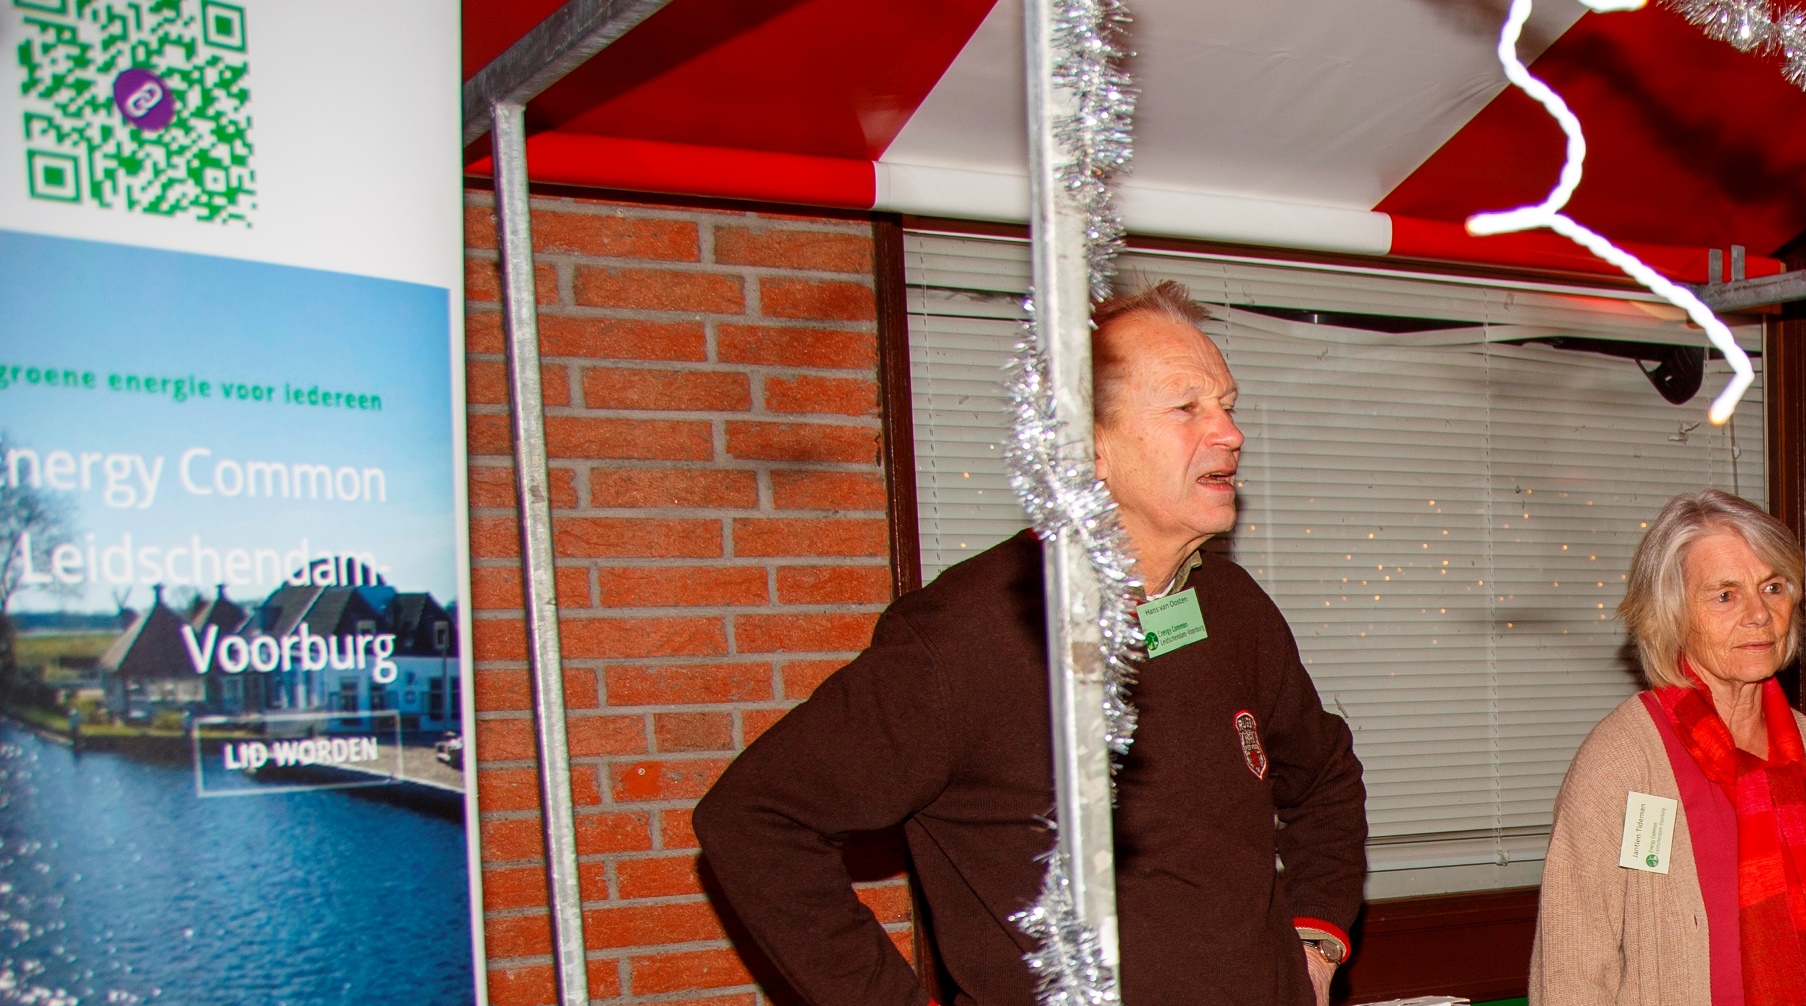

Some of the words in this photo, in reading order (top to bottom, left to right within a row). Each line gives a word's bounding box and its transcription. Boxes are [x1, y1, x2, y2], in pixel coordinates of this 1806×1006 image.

[108, 372, 211, 402] energie
[221, 382, 275, 401] voor
[285, 383, 383, 411] iedereen
[0, 447, 164, 505] nergy
[179, 447, 386, 502] Common
[20, 531, 391, 587] Leidschendam-
[180, 622, 398, 684] Voorburg
[224, 743, 267, 770] LID
[275, 737, 378, 766] WORDEN
